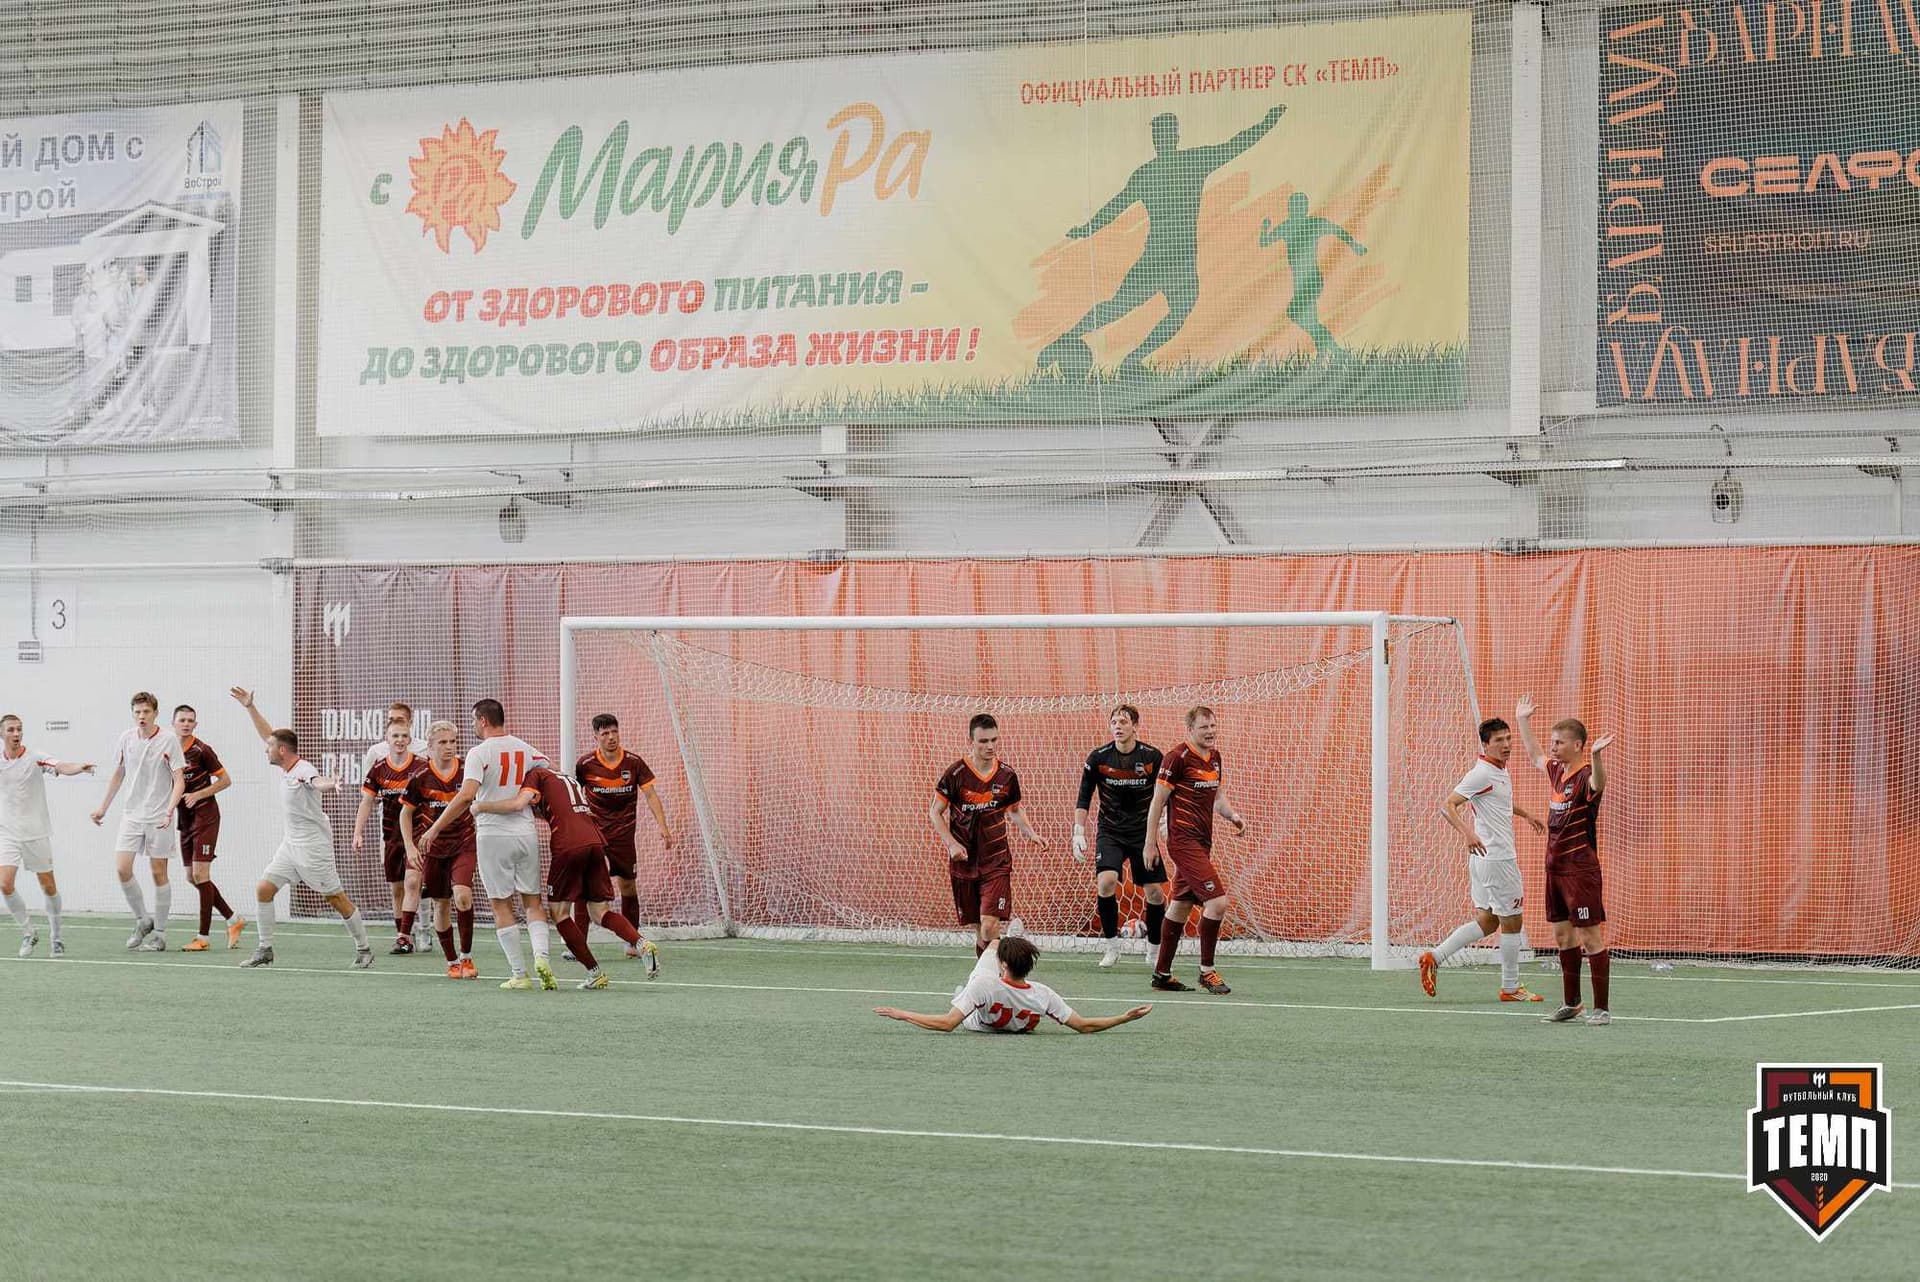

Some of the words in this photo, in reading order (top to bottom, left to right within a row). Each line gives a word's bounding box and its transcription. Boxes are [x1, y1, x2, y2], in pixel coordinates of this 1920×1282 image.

[1020, 67, 1182, 107] ОФИЦИАЛЬНЫЙ
[1188, 65, 1276, 95] ПАРТНЕР
[1282, 64, 1308, 87] СК
[1315, 56, 1400, 84] «ТЕМП»
[423, 290, 473, 323] ОТ
[477, 280, 705, 327] ЗДОРОВОГО
[714, 270, 904, 312] ПИТАНИЯ
[360, 345, 415, 386] ДО
[419, 340, 642, 384] ЗДОРОВОГО
[649, 334, 797, 372] ОБРАЗА
[52, 599, 66, 629] 3
[321, 709, 384, 740] ТОЛЬКО
[499, 751, 524, 786] 11
[1577, 906, 1590, 920] 20
